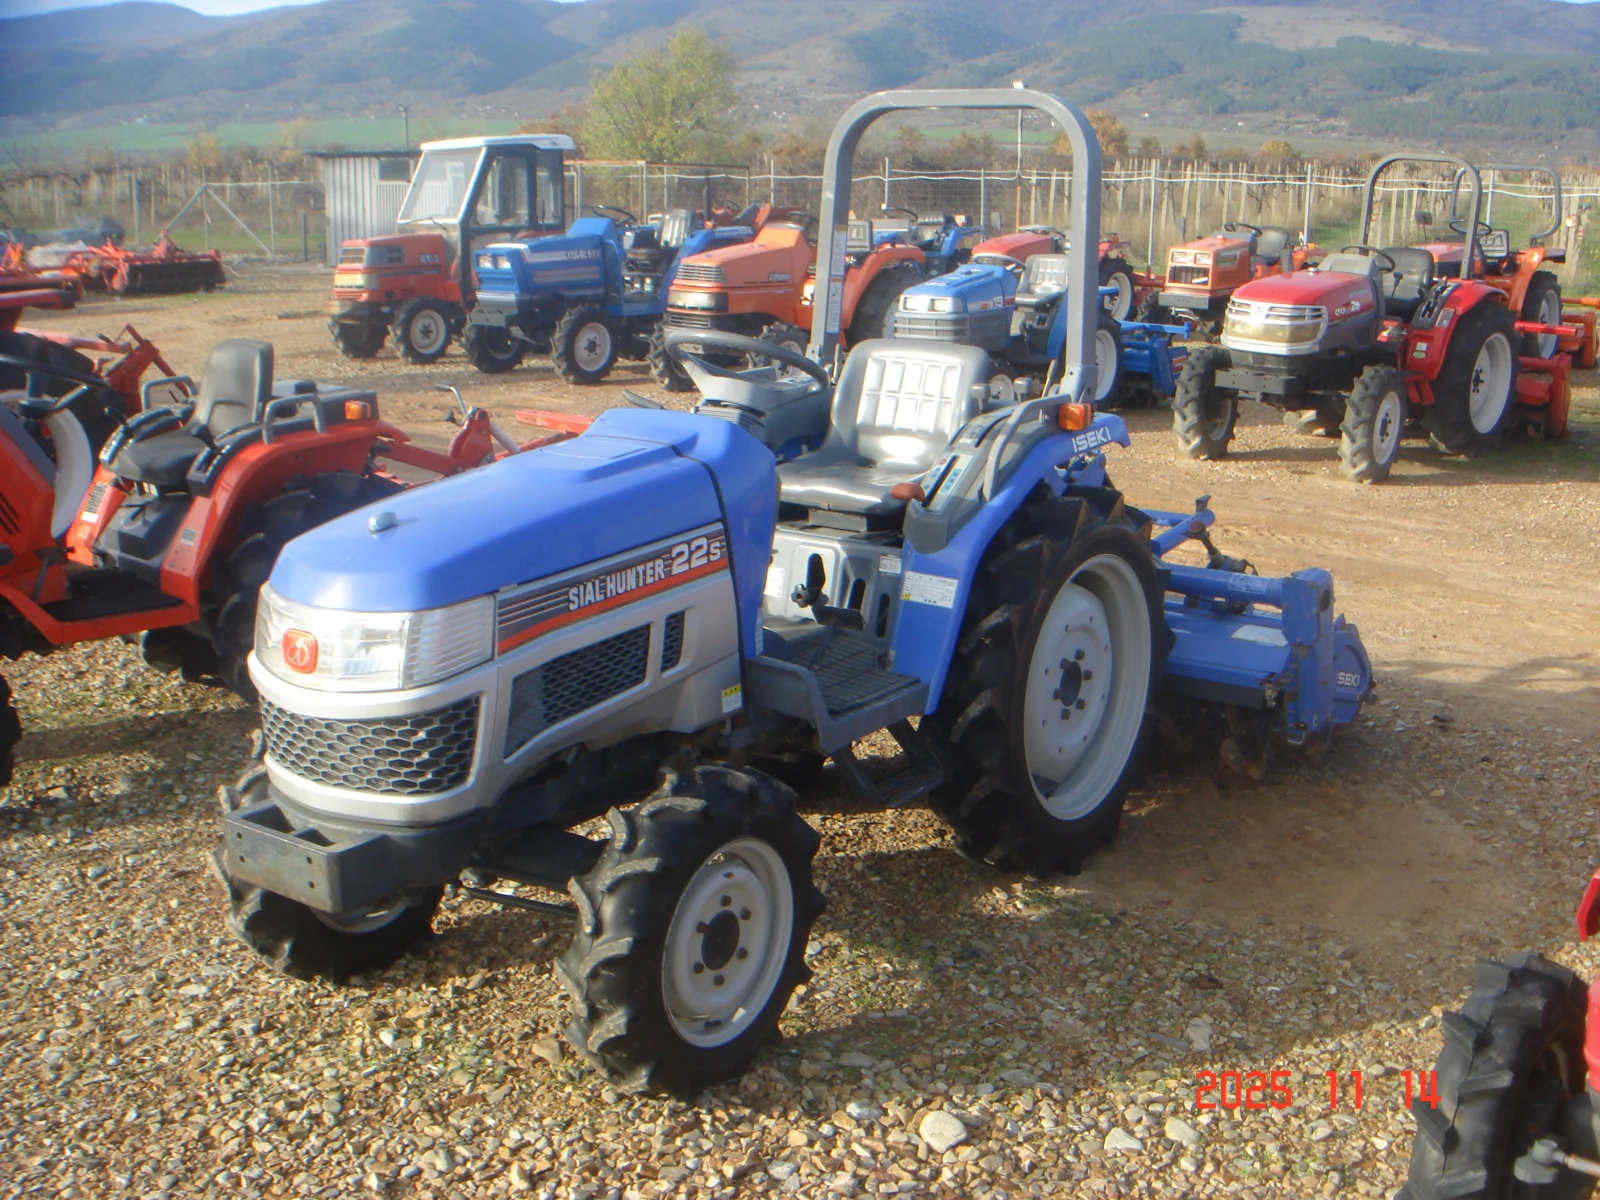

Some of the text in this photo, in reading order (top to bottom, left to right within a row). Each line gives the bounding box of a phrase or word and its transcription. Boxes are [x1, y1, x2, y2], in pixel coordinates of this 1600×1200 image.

[1071, 425, 1112, 453] ISEKI
[568, 579, 606, 612] SIAL
[605, 558, 666, 599] HUNTER
